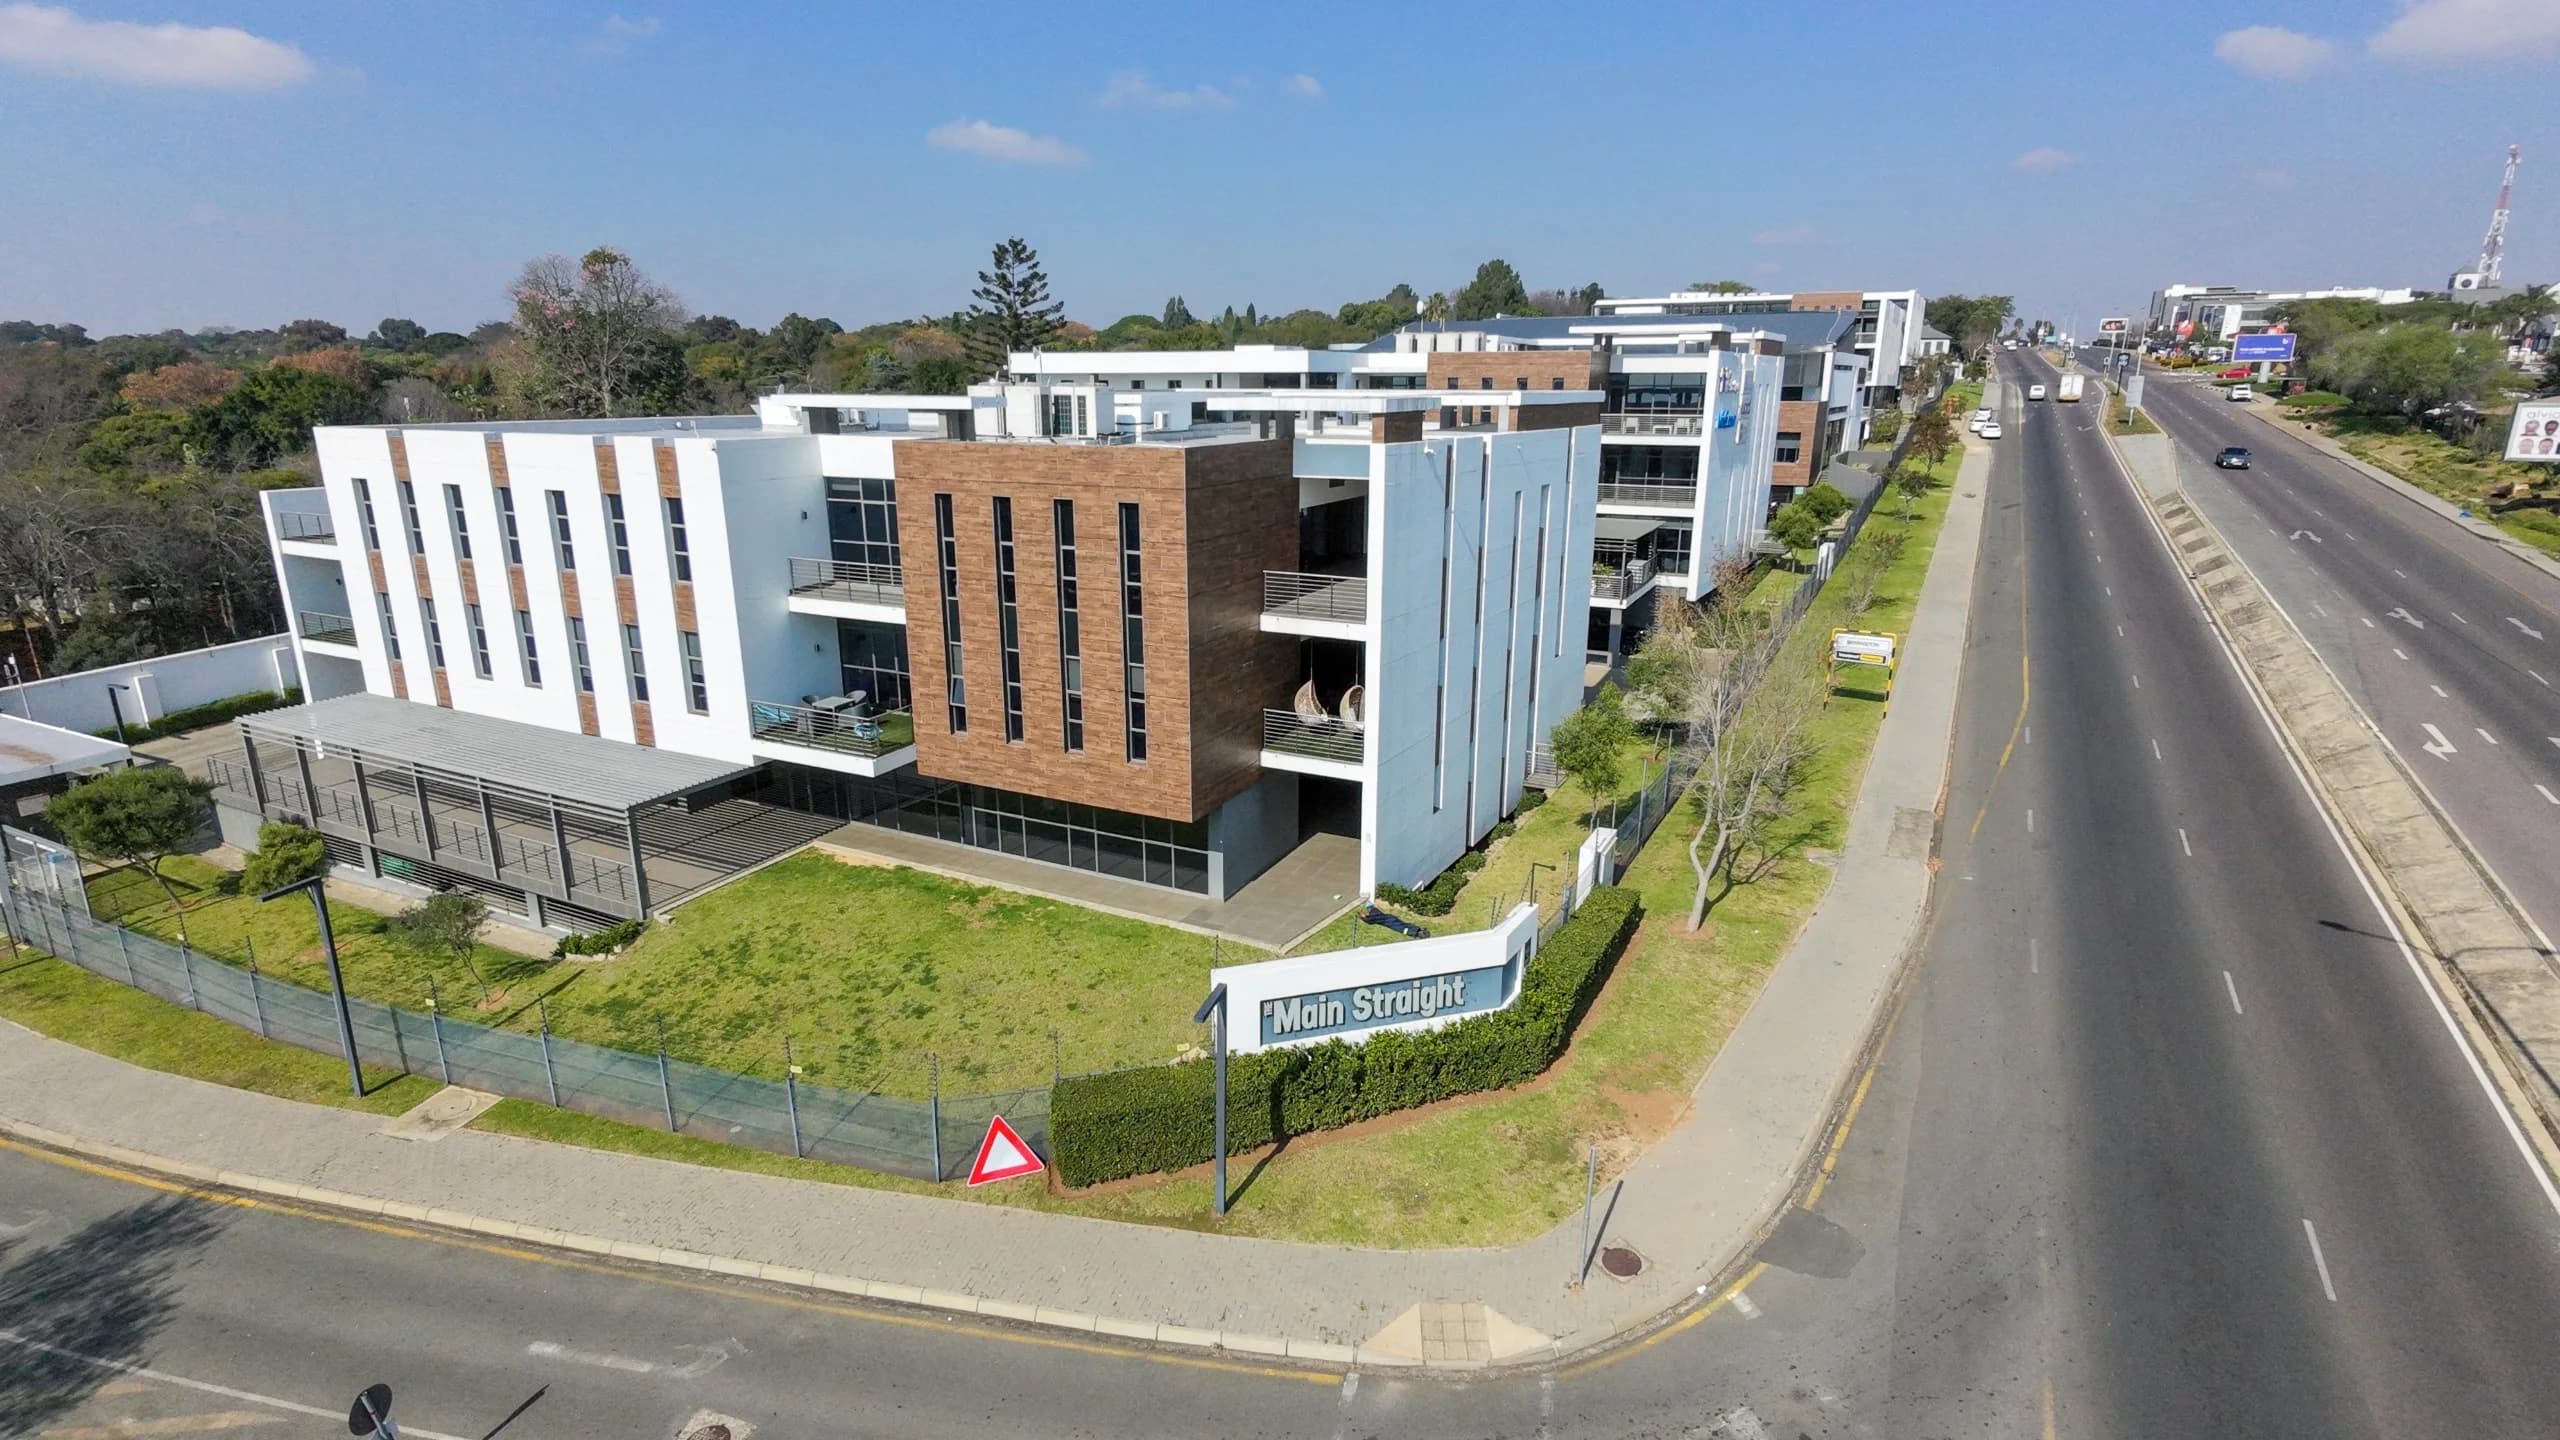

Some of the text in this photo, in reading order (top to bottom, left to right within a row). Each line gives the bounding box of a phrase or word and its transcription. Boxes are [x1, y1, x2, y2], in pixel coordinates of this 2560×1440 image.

[1263, 975, 1465, 1034] THE Main Straight
